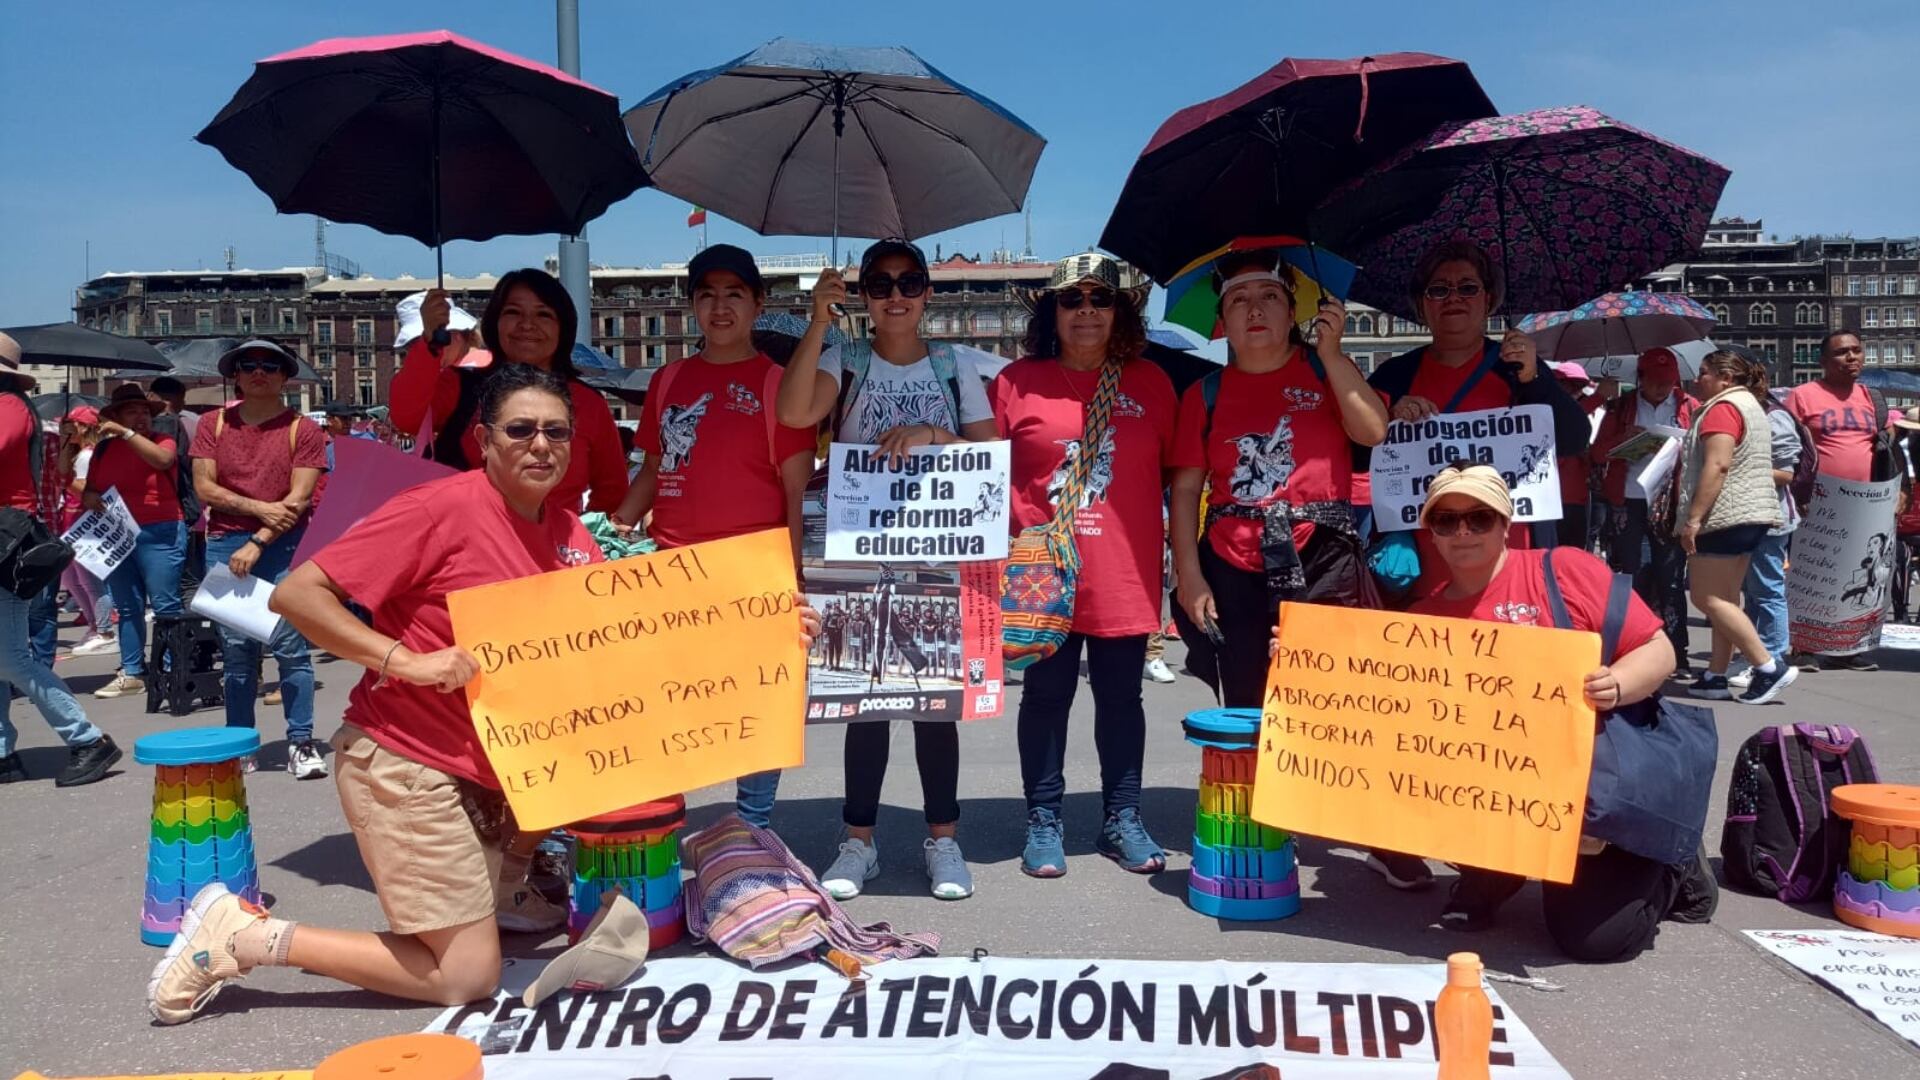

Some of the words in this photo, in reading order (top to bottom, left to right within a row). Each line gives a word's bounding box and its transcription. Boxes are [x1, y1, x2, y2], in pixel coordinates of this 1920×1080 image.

[866, 379, 941, 393] BALANC
[1384, 411, 1532, 445] Abrogación
[843, 447, 991, 476] Abrogación
[1428, 443, 1460, 466] de
[1468, 443, 1494, 463] la
[890, 479, 921, 501] de
[931, 478, 954, 500] la
[1839, 485, 1882, 498] Sección
[93, 523, 110, 539] de
[869, 506, 973, 528] reforma
[855, 533, 985, 555] educativa
[585, 561, 662, 597] CAM
[662, 604, 722, 631] PARA
[1383, 622, 1453, 657] CAM
[1471, 629, 1500, 659] 41
[661, 675, 738, 704] PARA
[758, 663, 790, 686] LA
[1277, 646, 1334, 672] PARO
[1348, 656, 1453, 687] NACIONAL
[1465, 673, 1515, 698] POR
[1532, 682, 1568, 705] LA
[1267, 684, 1411, 715] ABROGACIÓN
[1428, 699, 1467, 725] DE
[1493, 709, 1527, 738] LA
[507, 760, 558, 794] LEY
[585, 746, 643, 775] DEL
[662, 717, 760, 756] ISSSTE
[1264, 712, 1376, 747] REFORMA
[1397, 733, 1541, 777] EDUCATIVA
[444, 982, 711, 1055] CENTRO
[719, 979, 817, 1041] DE
[821, 964, 1156, 1042] ATENCIÓN
